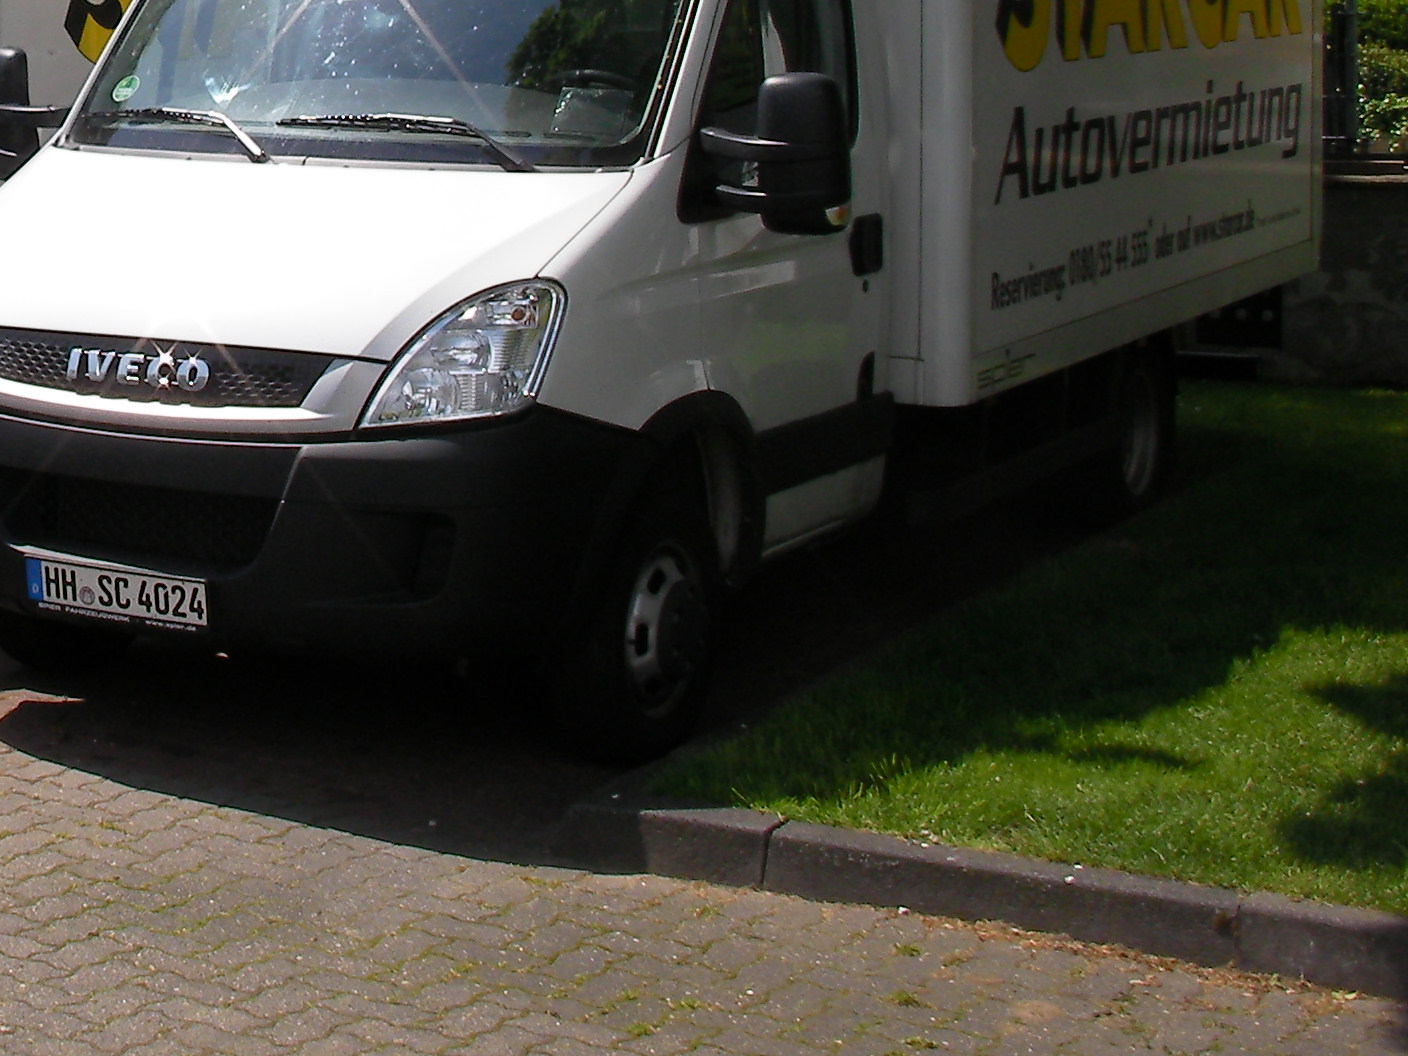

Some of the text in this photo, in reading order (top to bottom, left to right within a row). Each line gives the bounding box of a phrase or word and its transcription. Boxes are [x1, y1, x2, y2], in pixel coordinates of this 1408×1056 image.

[994, 80, 1303, 205] Autovermietung
[66, 347, 210, 392] IVECO
[44, 565, 205, 620] HH SC 4024
